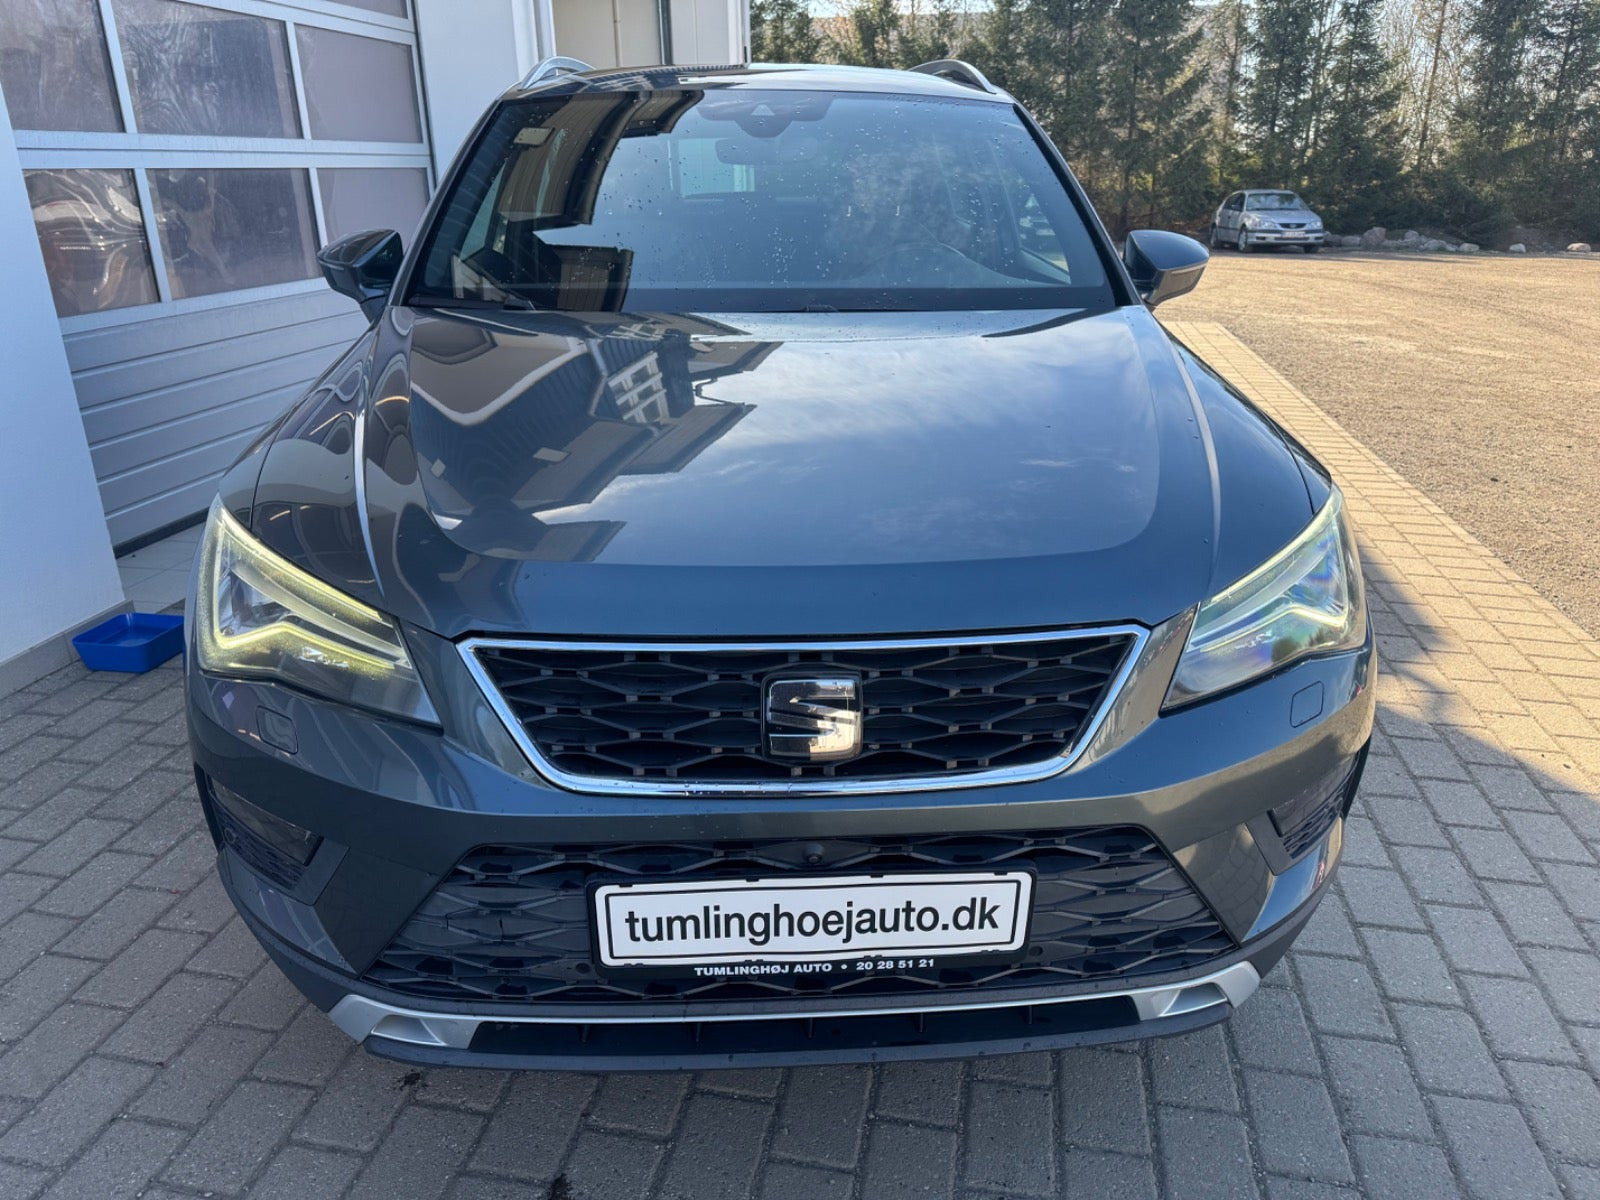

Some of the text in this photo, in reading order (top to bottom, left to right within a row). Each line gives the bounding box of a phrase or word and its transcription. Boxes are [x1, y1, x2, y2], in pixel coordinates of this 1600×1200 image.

[624, 897, 1000, 945] tumlinghoejauto.dk
[694, 958, 934, 976] TUMLINGHØJ AUTO 20 28 51 21
